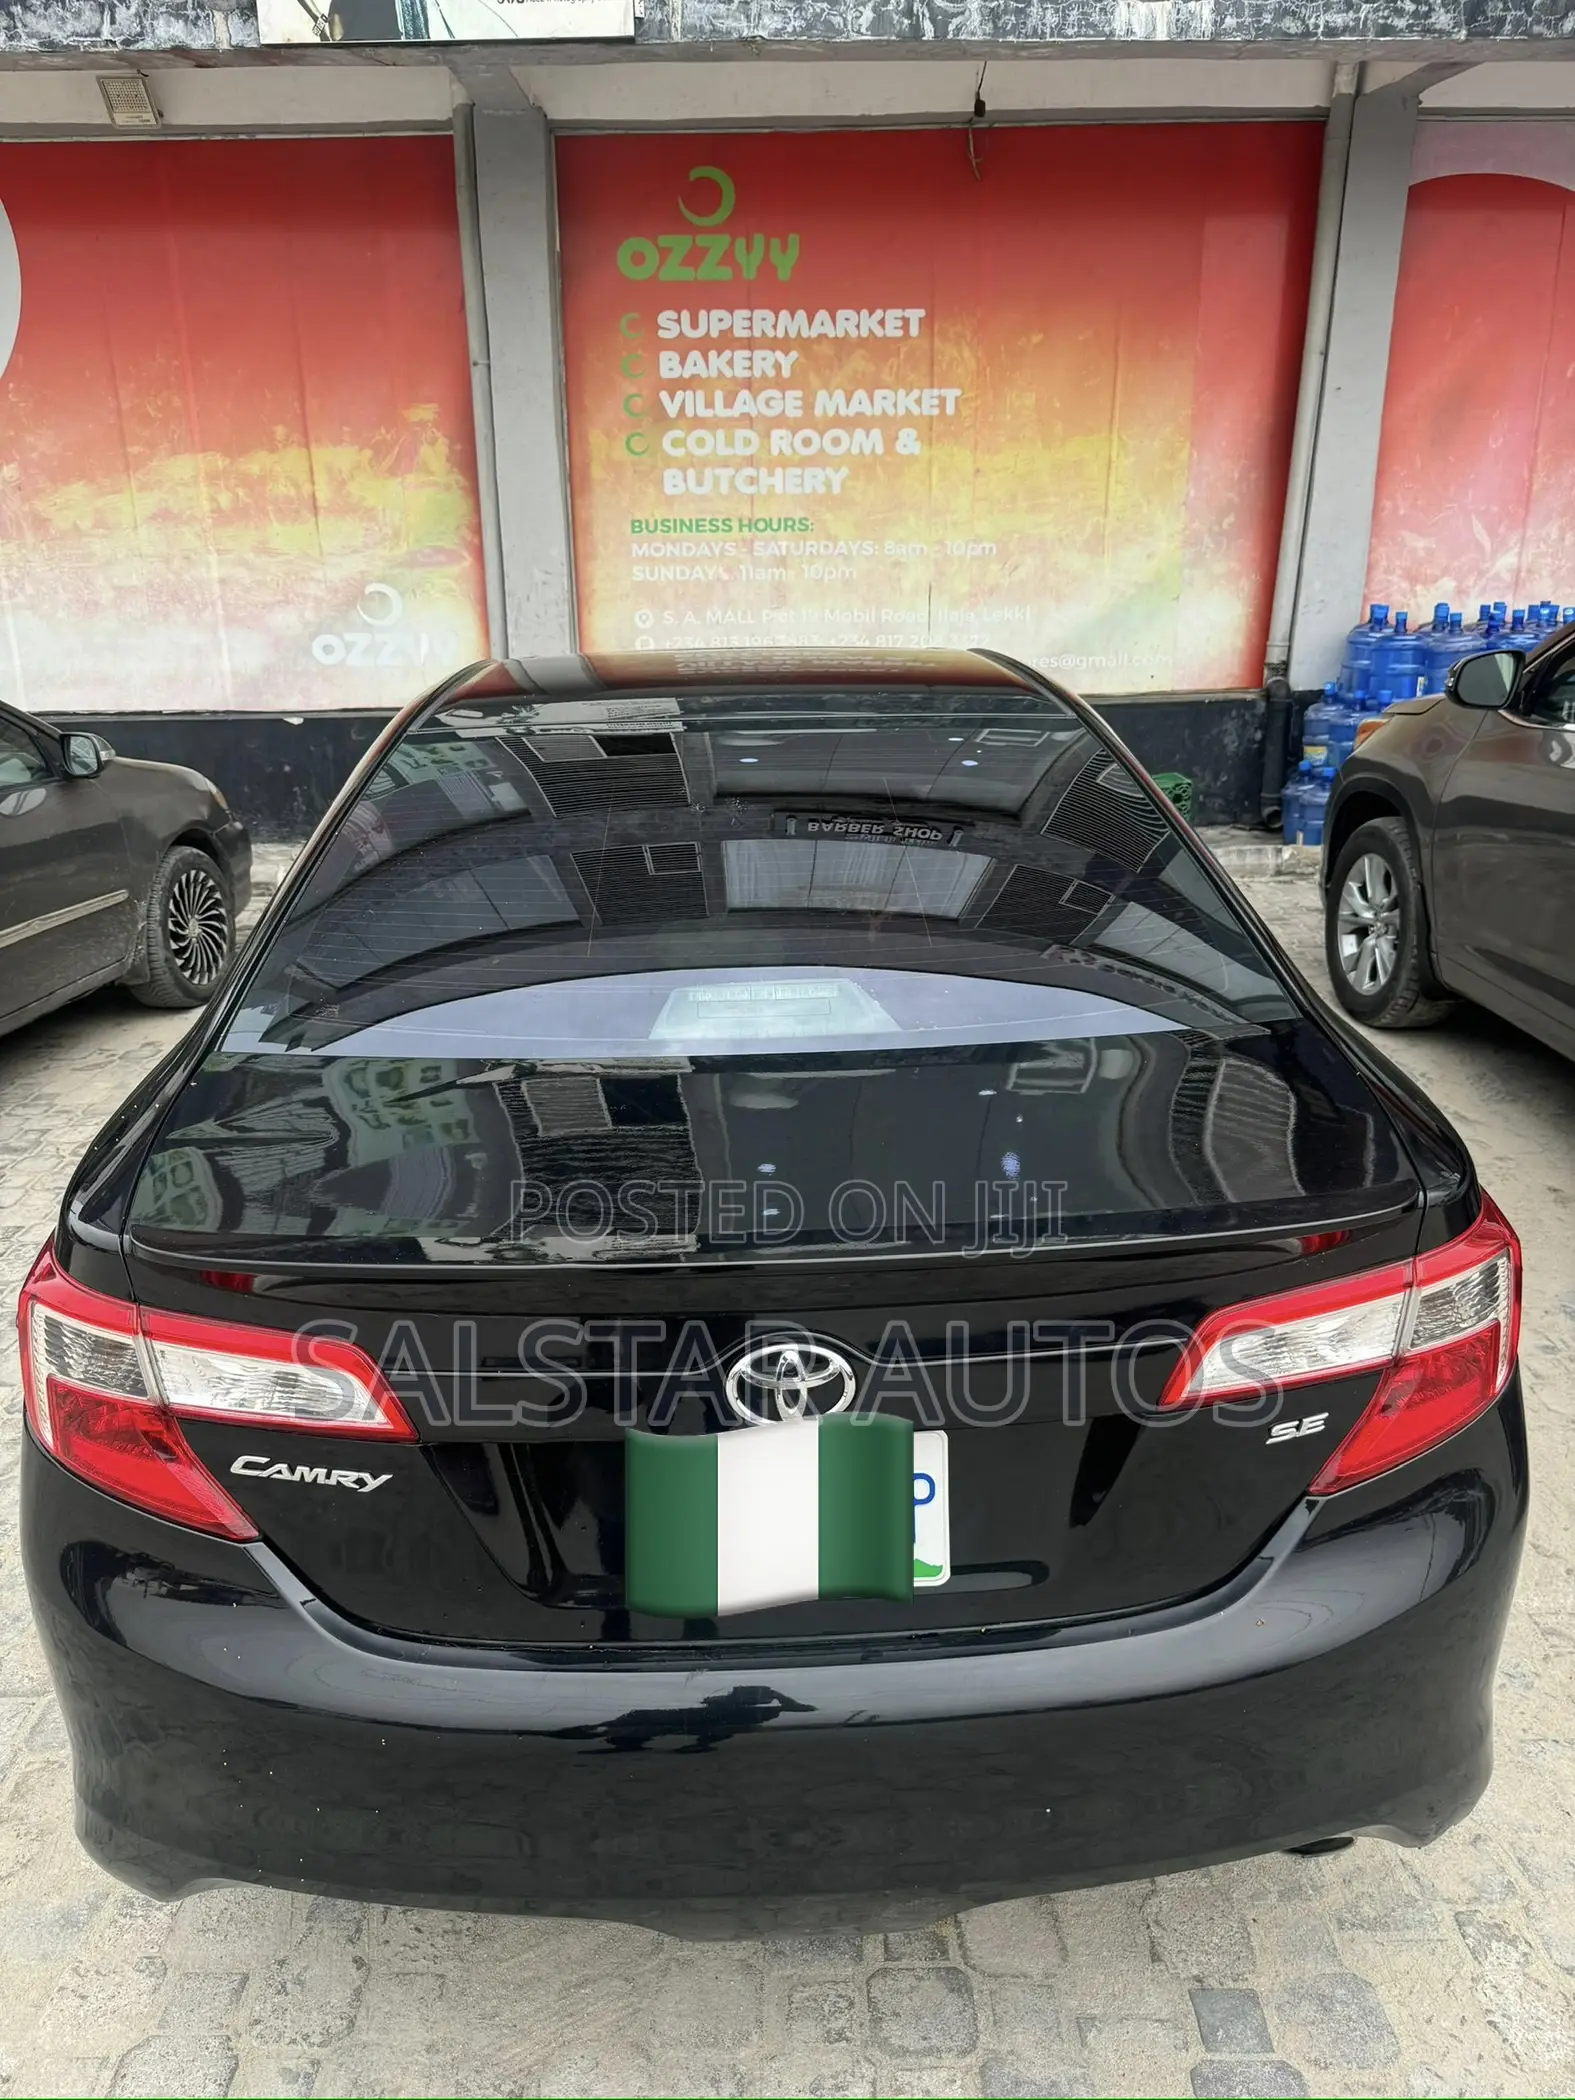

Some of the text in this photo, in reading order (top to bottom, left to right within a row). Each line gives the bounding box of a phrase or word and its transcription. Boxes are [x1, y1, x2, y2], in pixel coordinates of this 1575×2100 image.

[617, 233, 799, 281] OZZYY
[657, 308, 926, 338] SUPERMARKET
[658, 350, 798, 379] BAKERY
[659, 388, 963, 419] VILLAGE MARKET
[662, 427, 921, 457] COLD ROOM &
[662, 467, 849, 496] BUTCHERY
[630, 516, 815, 535] BUSINESS HOURS:
[631, 541, 737, 558] MONDAYS
[752, 540, 879, 557] SATURDAYS:
[884, 540, 928, 557] 8am
[945, 540, 997, 561] 10pm
[801, 564, 857, 584] 10pm
[706, 609, 756, 625] MALL
[824, 607, 875, 624] Mobil
[1265, 1411, 1330, 1445] SE
[229, 1454, 394, 1494] CAMRY
